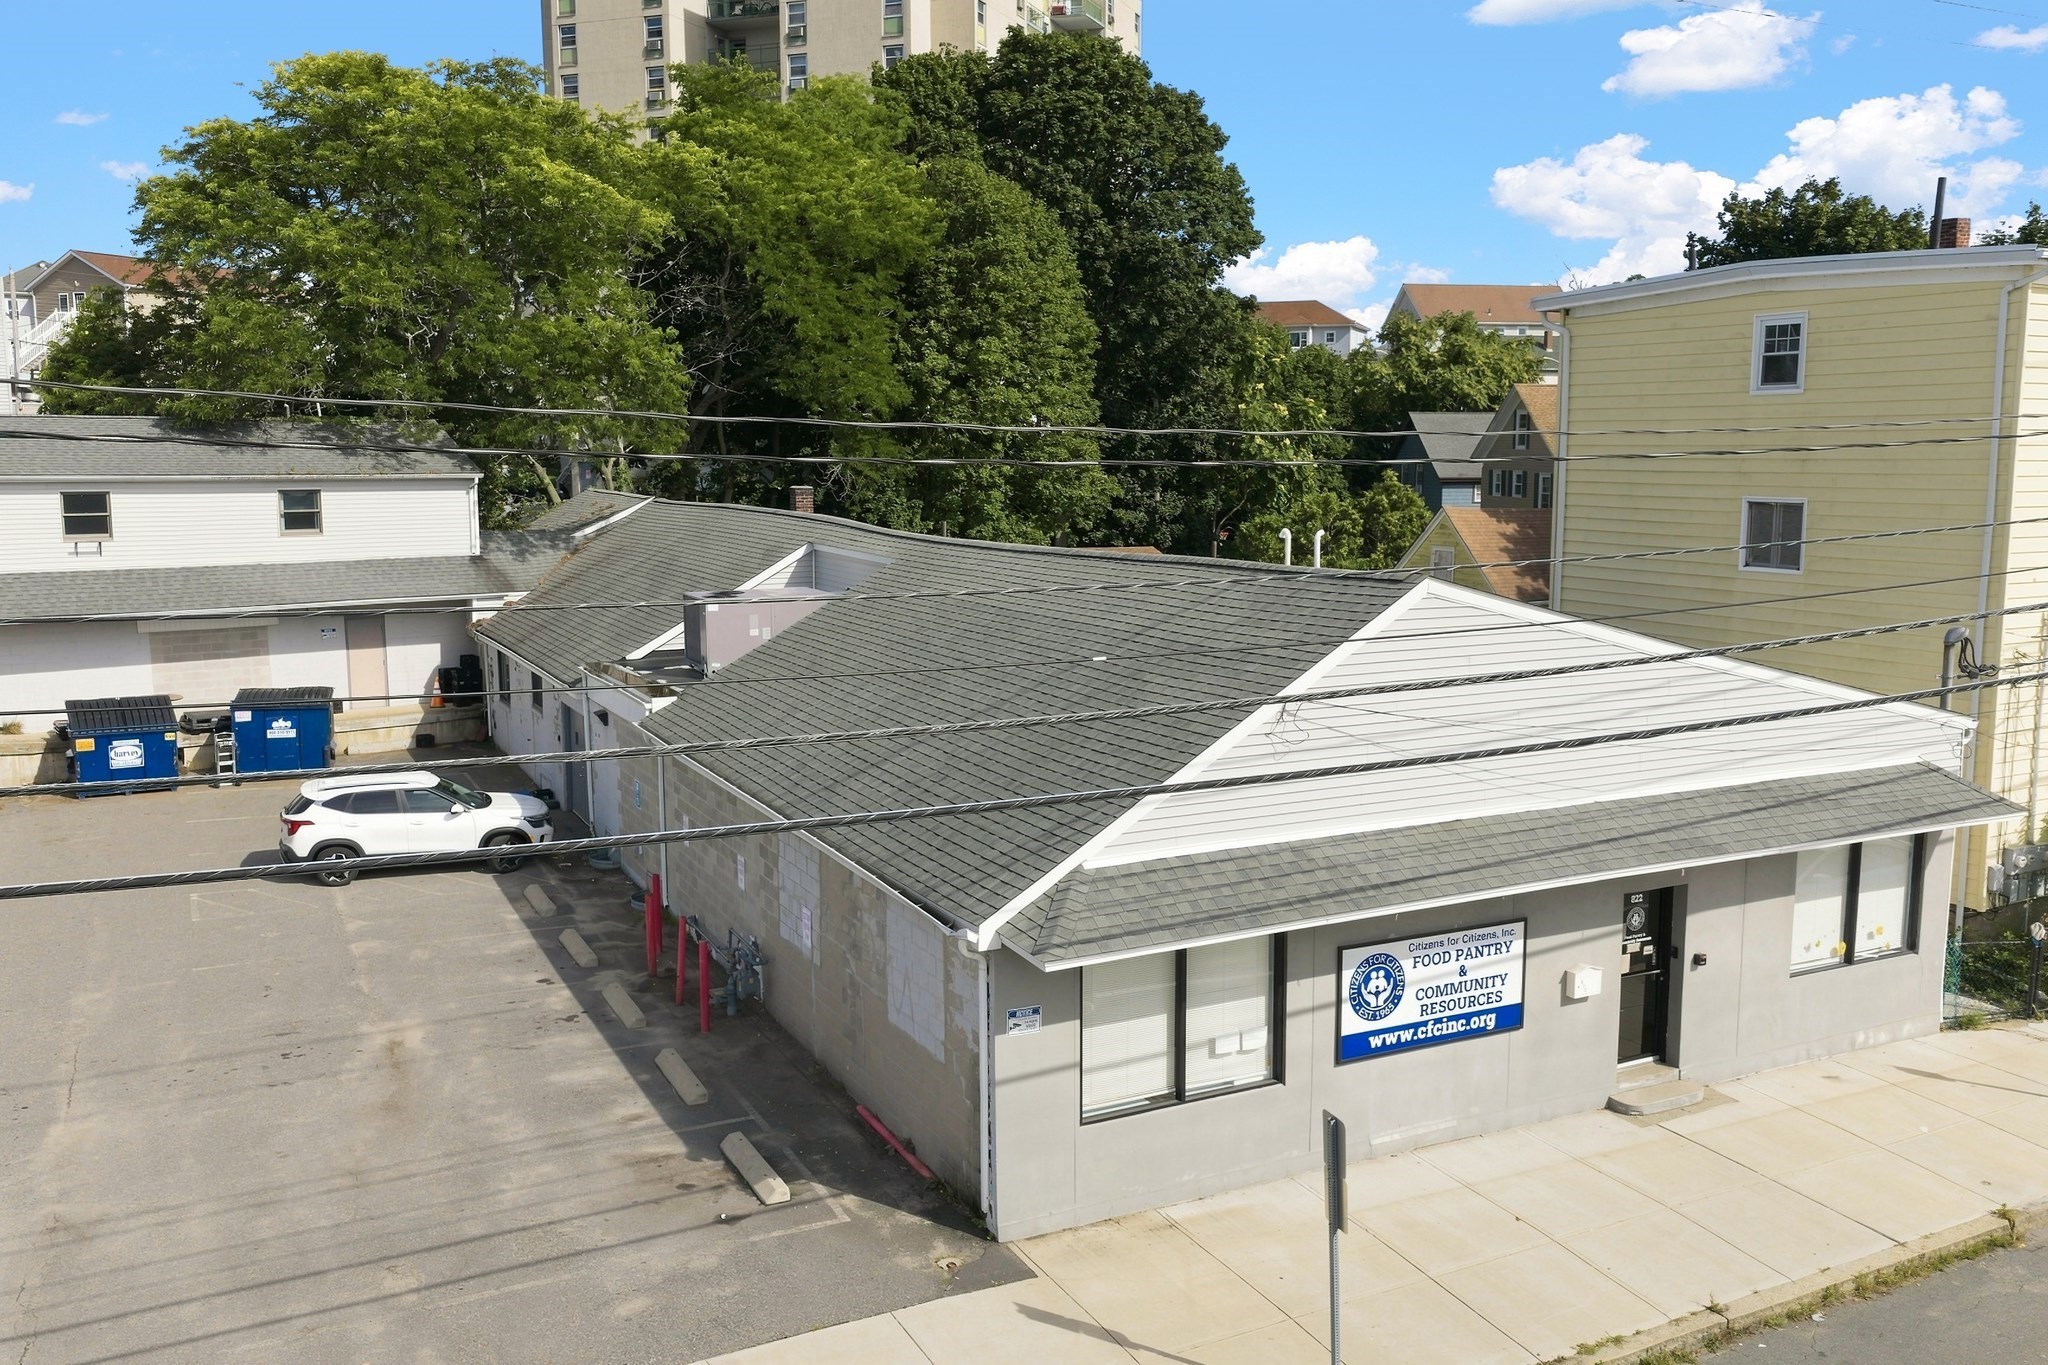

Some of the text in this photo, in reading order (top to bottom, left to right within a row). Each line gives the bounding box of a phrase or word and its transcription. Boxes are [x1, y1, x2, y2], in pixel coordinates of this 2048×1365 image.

[1631, 894, 1643, 903] 822
[1408, 940, 1445, 953] Citizens
[1447, 937, 1460, 946] for
[1501, 928, 1516, 937] Inc.
[1412, 940, 1514, 969] FOOD PANTRY
[1350, 954, 1404, 1005] CITIZENS FOR CITIZENS
[1458, 964, 1467, 977] &
[1415, 973, 1508, 1001] COMMUNITY
[1358, 1002, 1395, 1020] EST. 1965
[1419, 990, 1503, 1017] RESOURCES
[1368, 1012, 1497, 1049] www.cfcinc.org
